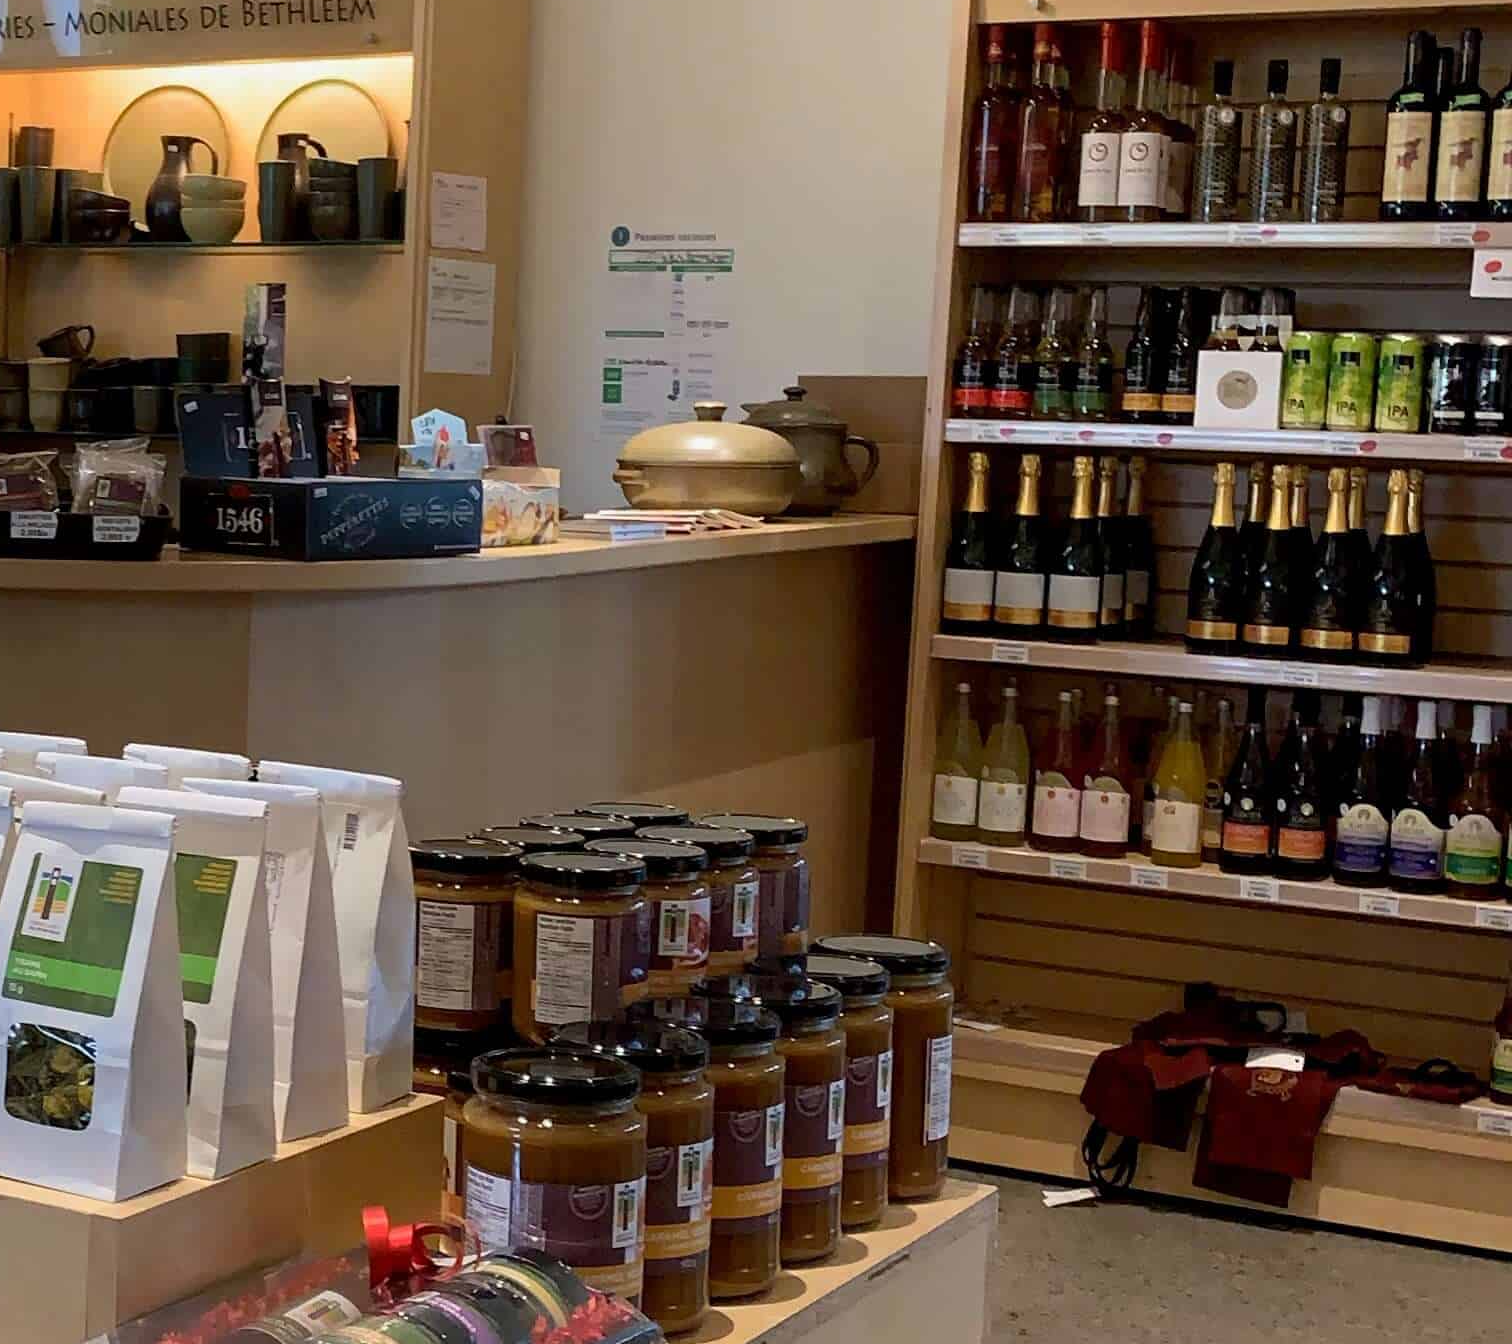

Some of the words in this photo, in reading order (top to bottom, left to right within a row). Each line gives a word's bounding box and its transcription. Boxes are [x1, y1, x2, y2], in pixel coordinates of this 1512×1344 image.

[64, 7, 189, 37] MONIALES
[199, 4, 229, 30] DE
[1335, 400, 1358, 414] IPA
[1387, 405, 1409, 418] IPA
[215, 507, 265, 535] 1546
